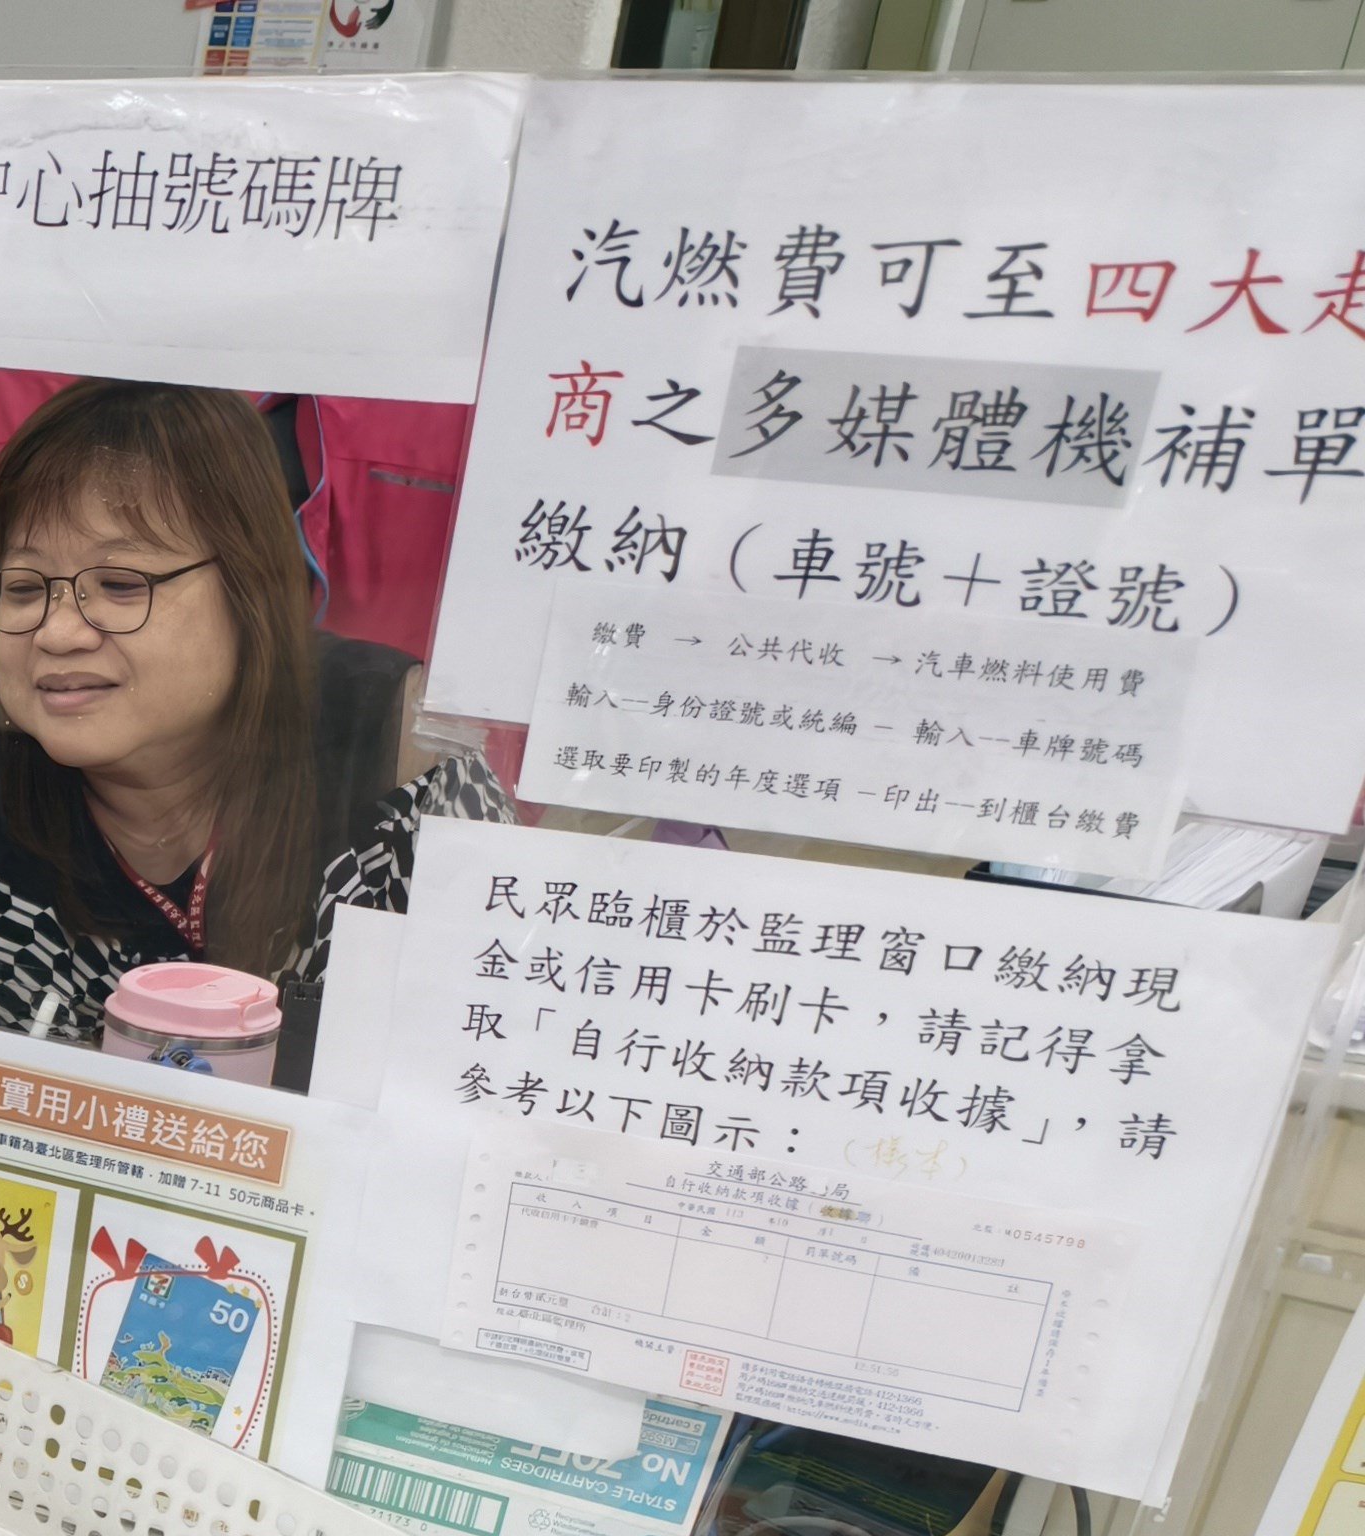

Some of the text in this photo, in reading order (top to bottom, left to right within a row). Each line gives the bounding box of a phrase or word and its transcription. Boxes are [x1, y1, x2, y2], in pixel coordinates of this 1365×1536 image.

[544, 360, 1365, 504] 商之多媒體機補單
[593, 621, 1145, 697] 繳費 公共代收 汽車燃料使用費
[553, 744, 842, 802] 選取要印製的年度選項
[485, 874, 1181, 1013] 民眾臨櫃於監理窗口繳納現
[474, 938, 1167, 1086] 金或信用卡刷卡，請記得拿
[454, 1062, 800, 1155] 參考以下圖示：
[461, 1003, 1178, 1160] 取「自行收納款項收據」，請
[0, 1077, 269, 1171] 實用小禮送給您
[190, 1178, 221, 1197] 7-11
[229, 1187, 316, 1218] 50元商品卡。
[666, 1175, 799, 1211] 自行收納款項收據
[708, 1160, 851, 1200] 交通部公路局
[209, 1299, 250, 1333] 50
[500, 1457, 609, 1495] CARTRIDGES
[611, 1483, 678, 1512] STAPLE
